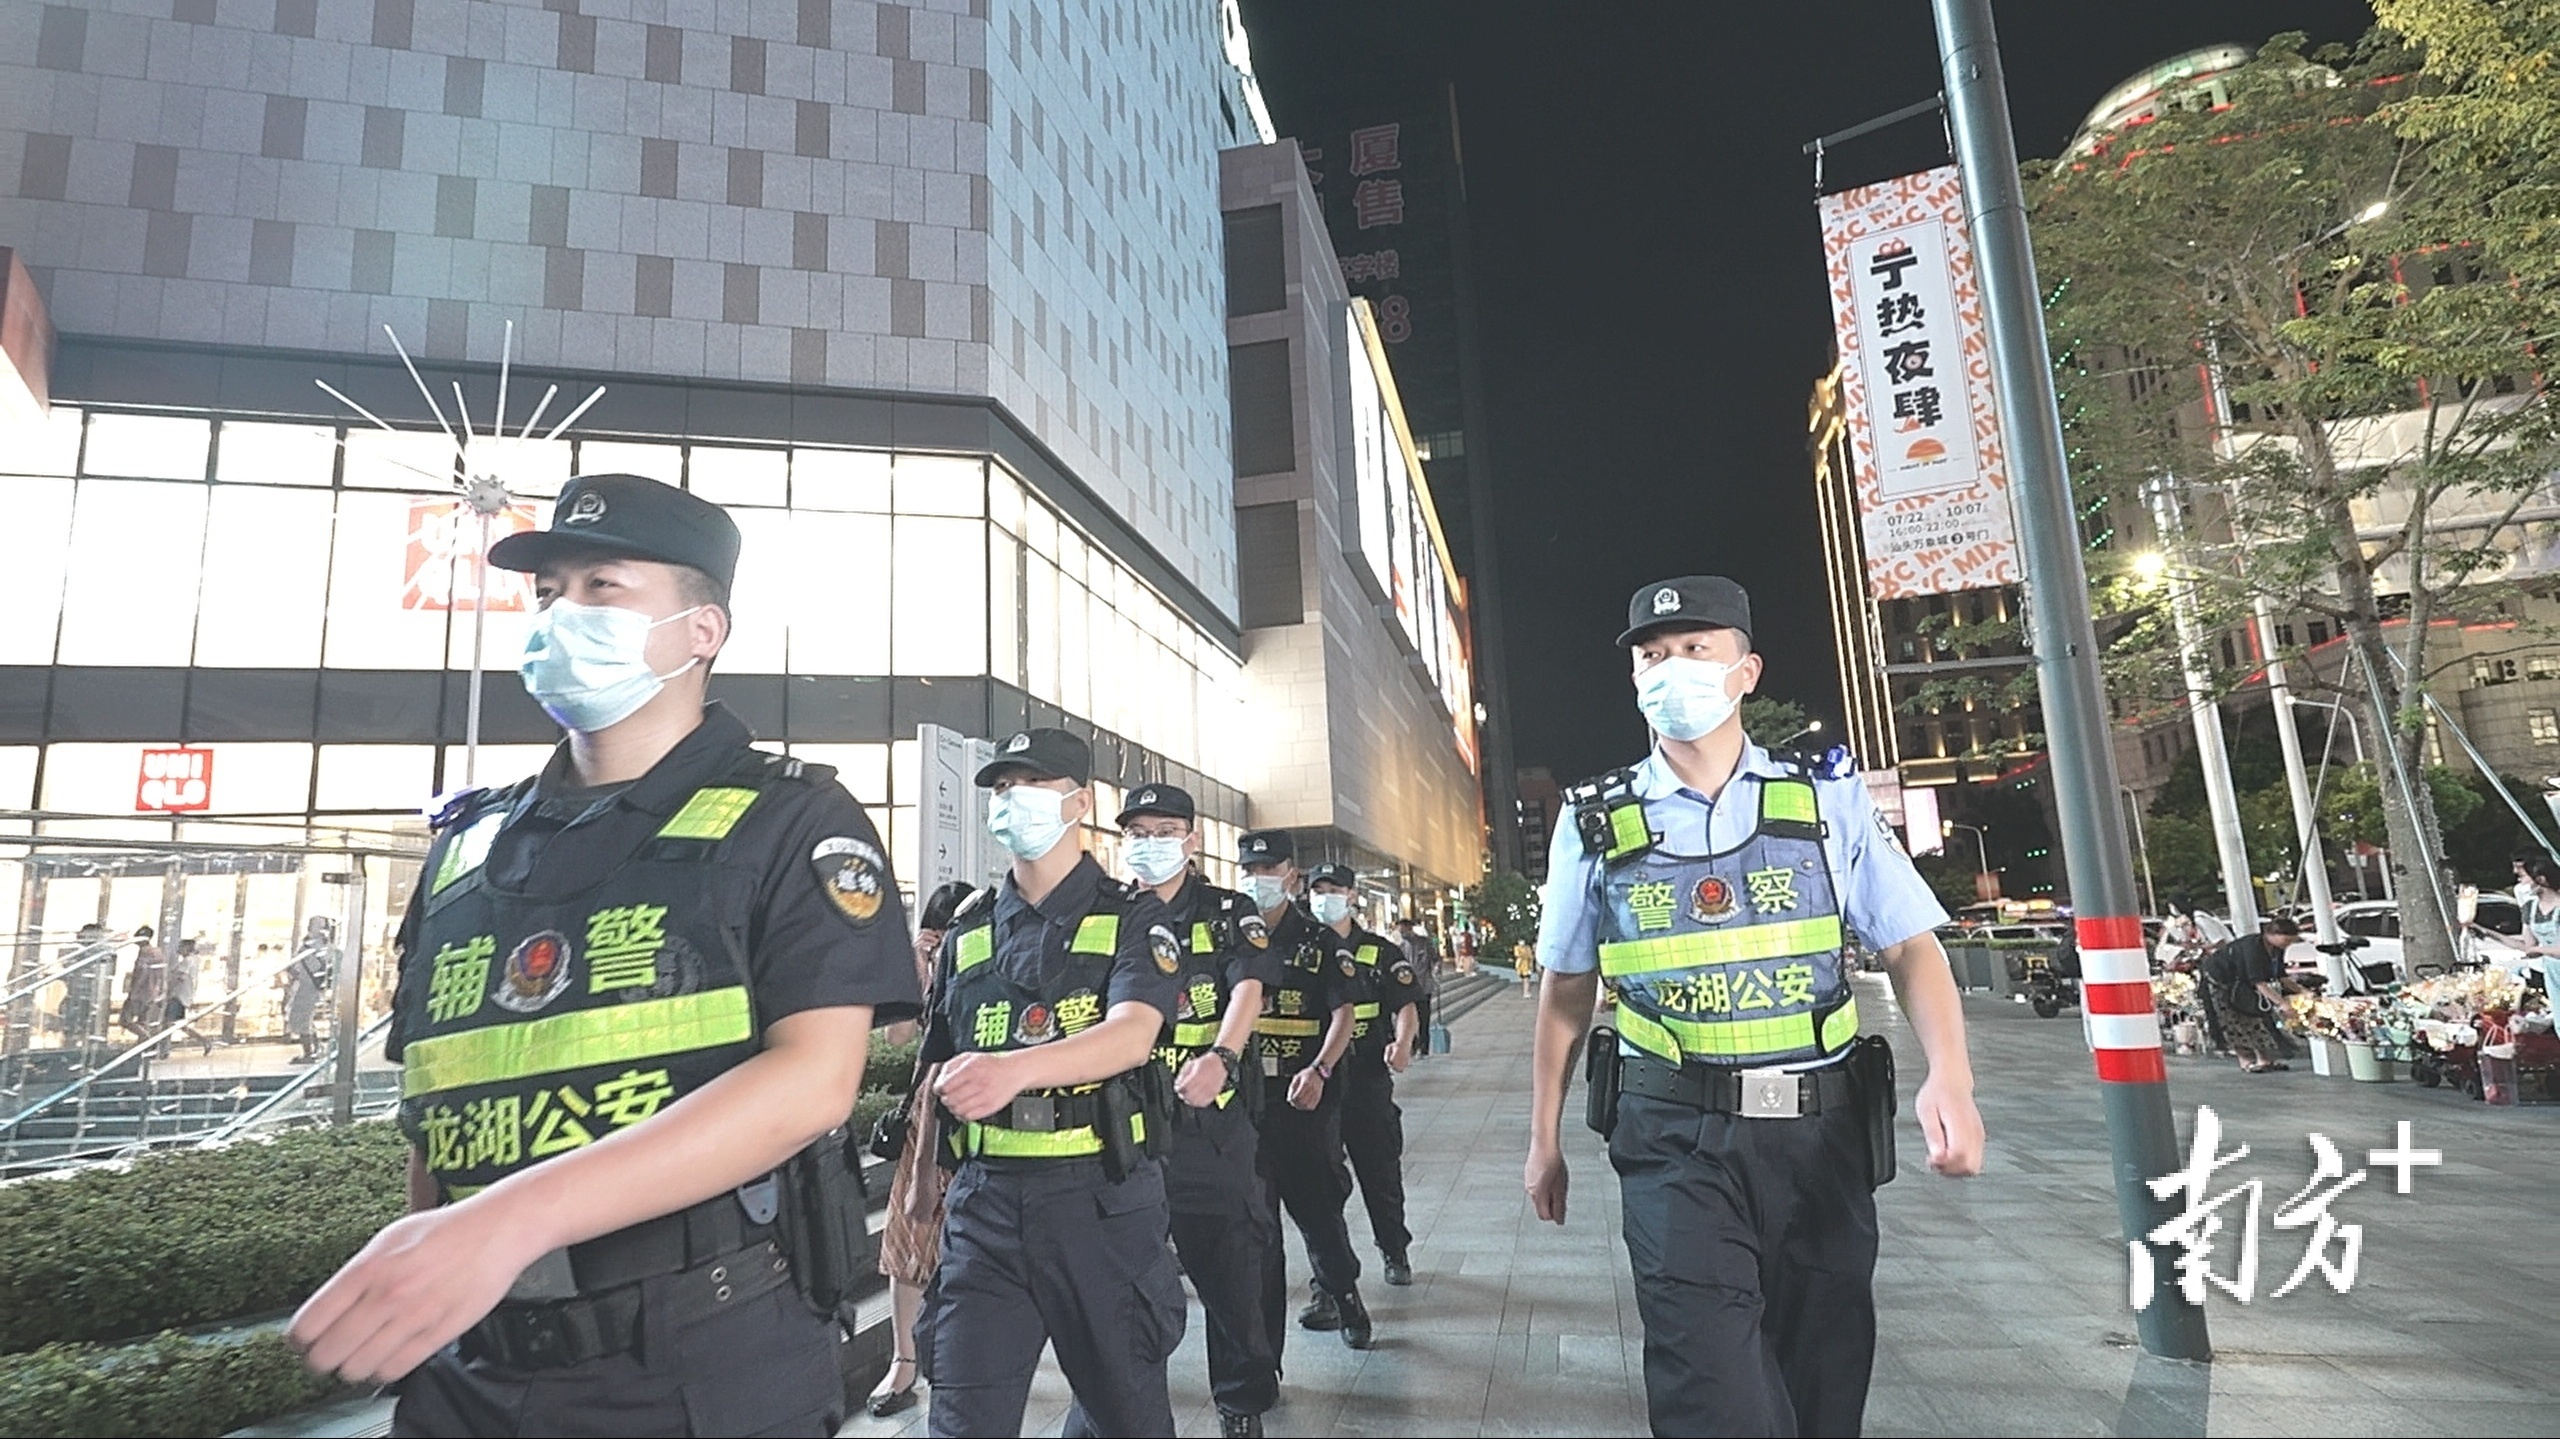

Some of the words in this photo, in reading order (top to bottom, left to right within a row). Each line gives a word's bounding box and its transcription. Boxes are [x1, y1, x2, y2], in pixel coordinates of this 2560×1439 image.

[1369, 295, 1412, 344] 8
[143, 753, 205, 779] UNI
[140, 779, 207, 810] QLO
[1627, 881, 1677, 931] 警
[1746, 866, 1799, 914] 察
[427, 935, 496, 1023] 辅
[583, 903, 669, 994] 警
[1188, 982, 1218, 1019] 警
[1651, 963, 1816, 1014] 龙湖公安
[973, 1000, 1012, 1048] 辅
[1055, 994, 1101, 1039] 警
[1260, 1038, 1302, 1058] 公安
[420, 1069, 675, 1174] 龙湖公安
